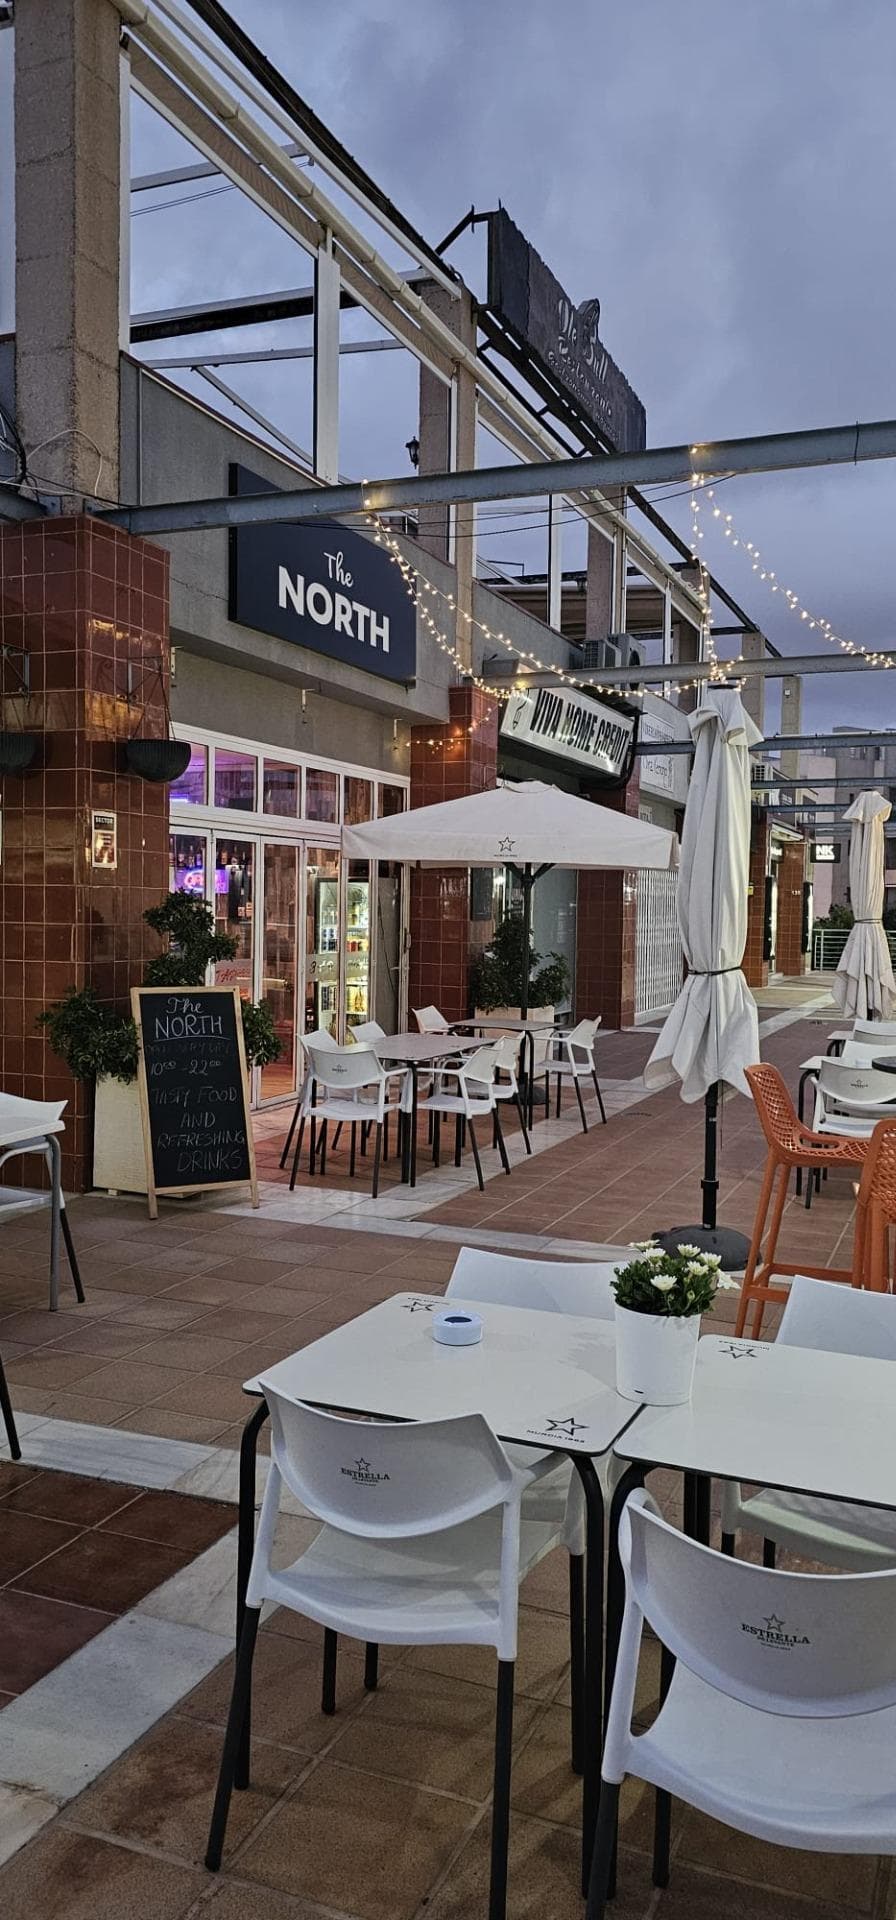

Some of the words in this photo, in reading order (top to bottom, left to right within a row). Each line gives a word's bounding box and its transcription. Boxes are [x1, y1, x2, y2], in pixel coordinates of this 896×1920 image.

[324, 551, 354, 588] The
[278, 565, 390, 653] NORTH
[530, 687, 564, 739] VIVA
[558, 702, 598, 752] HOME
[593, 718, 630, 765] CREDIT
[815, 844, 834, 856] NK
[166, 997, 205, 1014] The
[155, 1014, 223, 1039] NORTH
[151, 1086, 190, 1107] TASTY
[198, 1085, 237, 1104] FOOD
[180, 1111, 216, 1128] AND
[157, 1130, 245, 1149] REFRESHING
[177, 1149, 242, 1172] DRINKS
[340, 1467, 391, 1481] ESTRELLA
[741, 1623, 811, 1645] ESTRELLA
